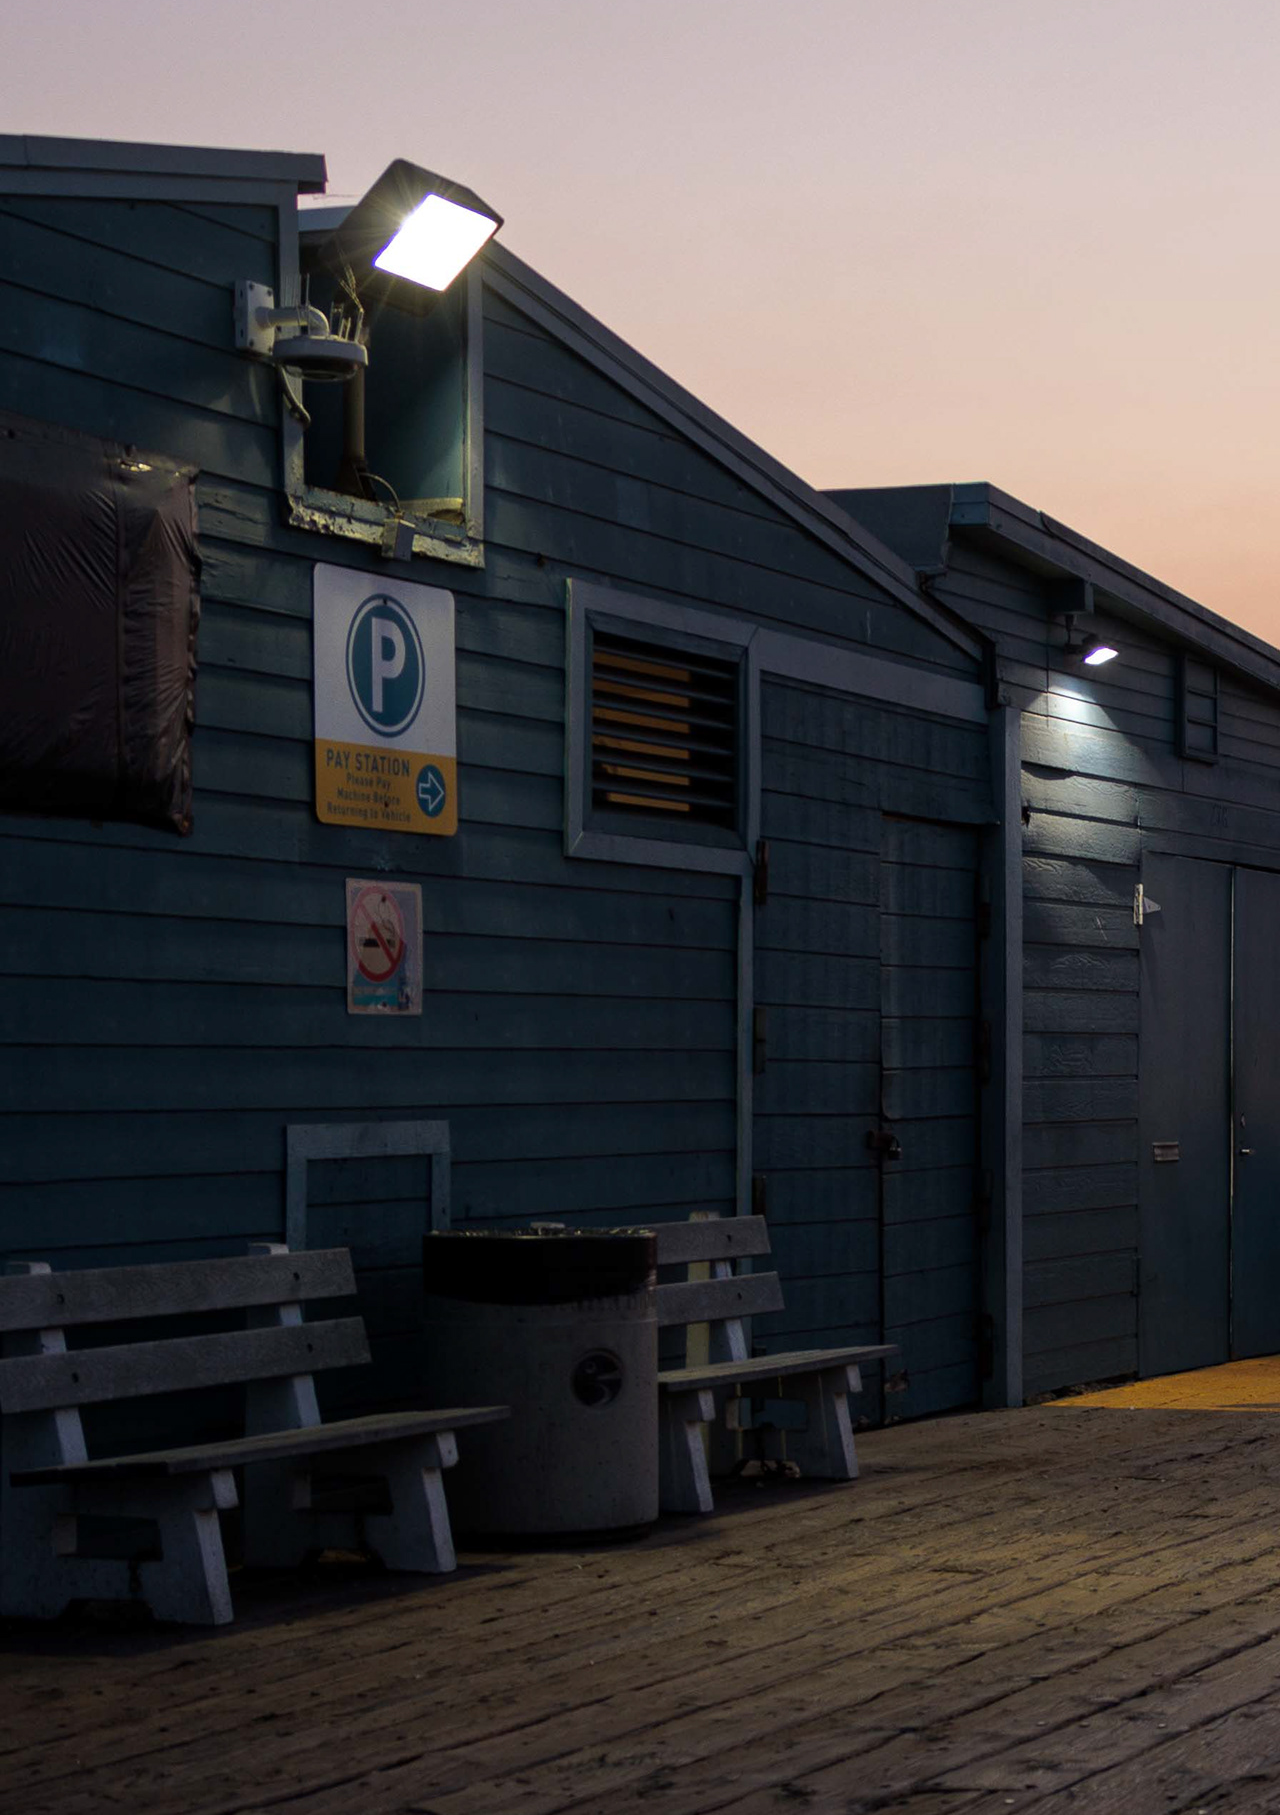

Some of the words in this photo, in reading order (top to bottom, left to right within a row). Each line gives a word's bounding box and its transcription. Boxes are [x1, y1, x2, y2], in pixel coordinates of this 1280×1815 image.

[371, 616, 406, 714] P
[326, 748, 350, 770] PAY
[355, 752, 410, 777] STATION
[346, 772, 373, 787] Please
[376, 776, 391, 791] Pay
[337, 786, 370, 801] Machine
[373, 791, 400, 806] Before
[327, 801, 368, 821] Returning
[381, 809, 412, 823] Vehicle
